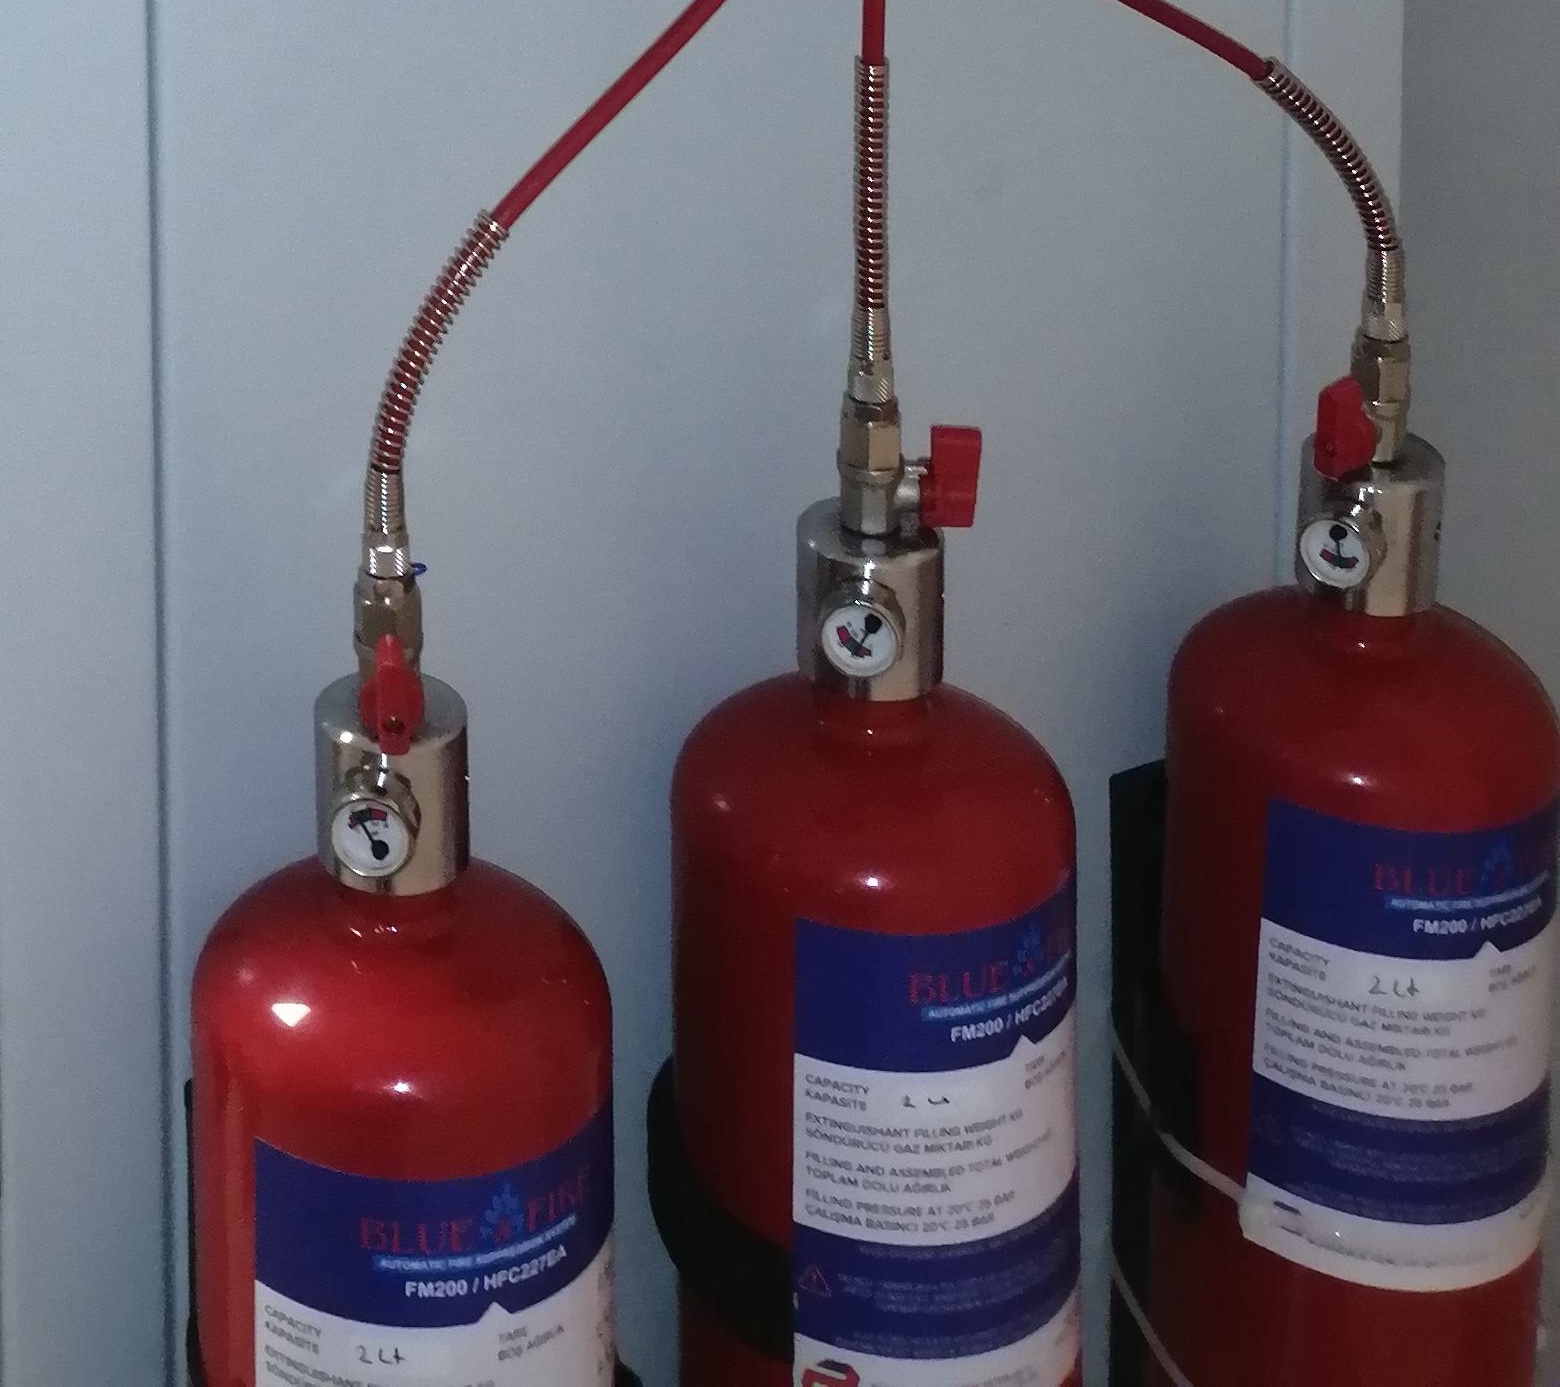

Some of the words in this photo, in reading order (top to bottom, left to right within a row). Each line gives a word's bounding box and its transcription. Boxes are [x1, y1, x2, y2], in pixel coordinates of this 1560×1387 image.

[1413, 918, 1467, 935] FM200
[909, 961, 1008, 1003] BLUE
[1369, 975, 1388, 995] 2
[950, 1017, 1004, 1043] FM200
[805, 1074, 869, 1094] CAPACITY
[360, 1217, 473, 1256] BLUE
[405, 1279, 468, 1298] FM200
[356, 1345, 372, 1364] 2
